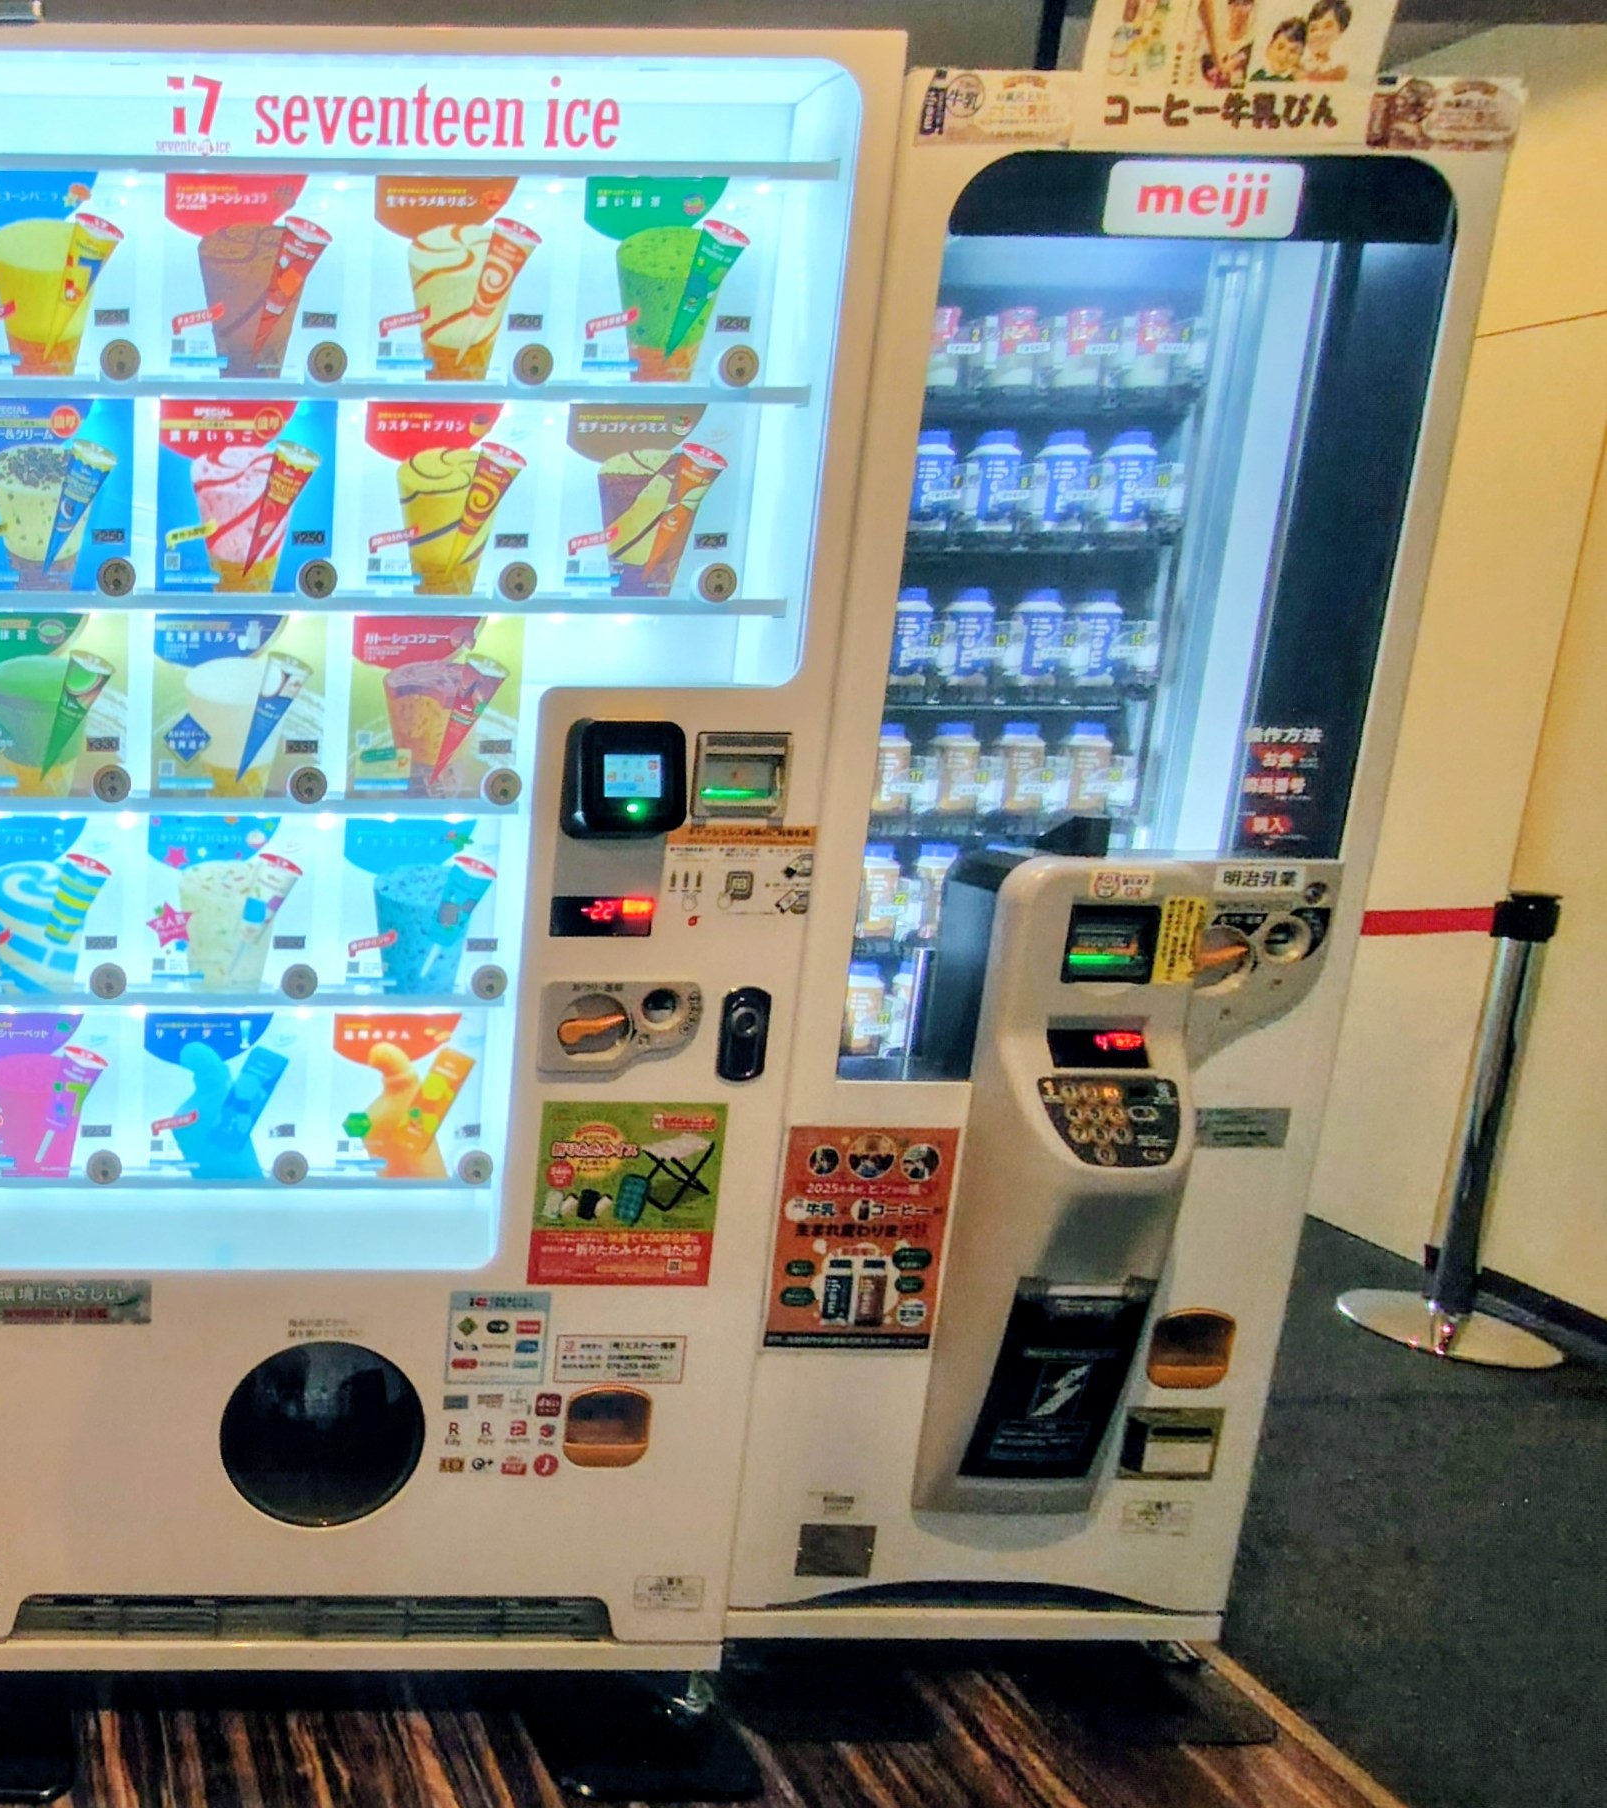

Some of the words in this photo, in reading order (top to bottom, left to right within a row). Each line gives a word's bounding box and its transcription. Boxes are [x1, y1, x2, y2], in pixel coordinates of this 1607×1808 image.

[255, 83, 525, 147] seventeen
[544, 76, 621, 149] ice
[1104, 92, 1338, 129] コーヒー牛乳びん
[385, 196, 479, 207] 生キャラメルリボン
[1136, 173, 1270, 228] meiji
[376, 420, 466, 432] カスタードプリン
[577, 421, 667, 434] 生チョコティラミス
[169, 430, 253, 442] 濃厚いちご
[1118, 460, 1142, 514] meiji
[165, 631, 236, 642] 北海道ミルク
[1223, 870, 1297, 887] 明治乳業
[827, 1278, 842, 1314] meiji
